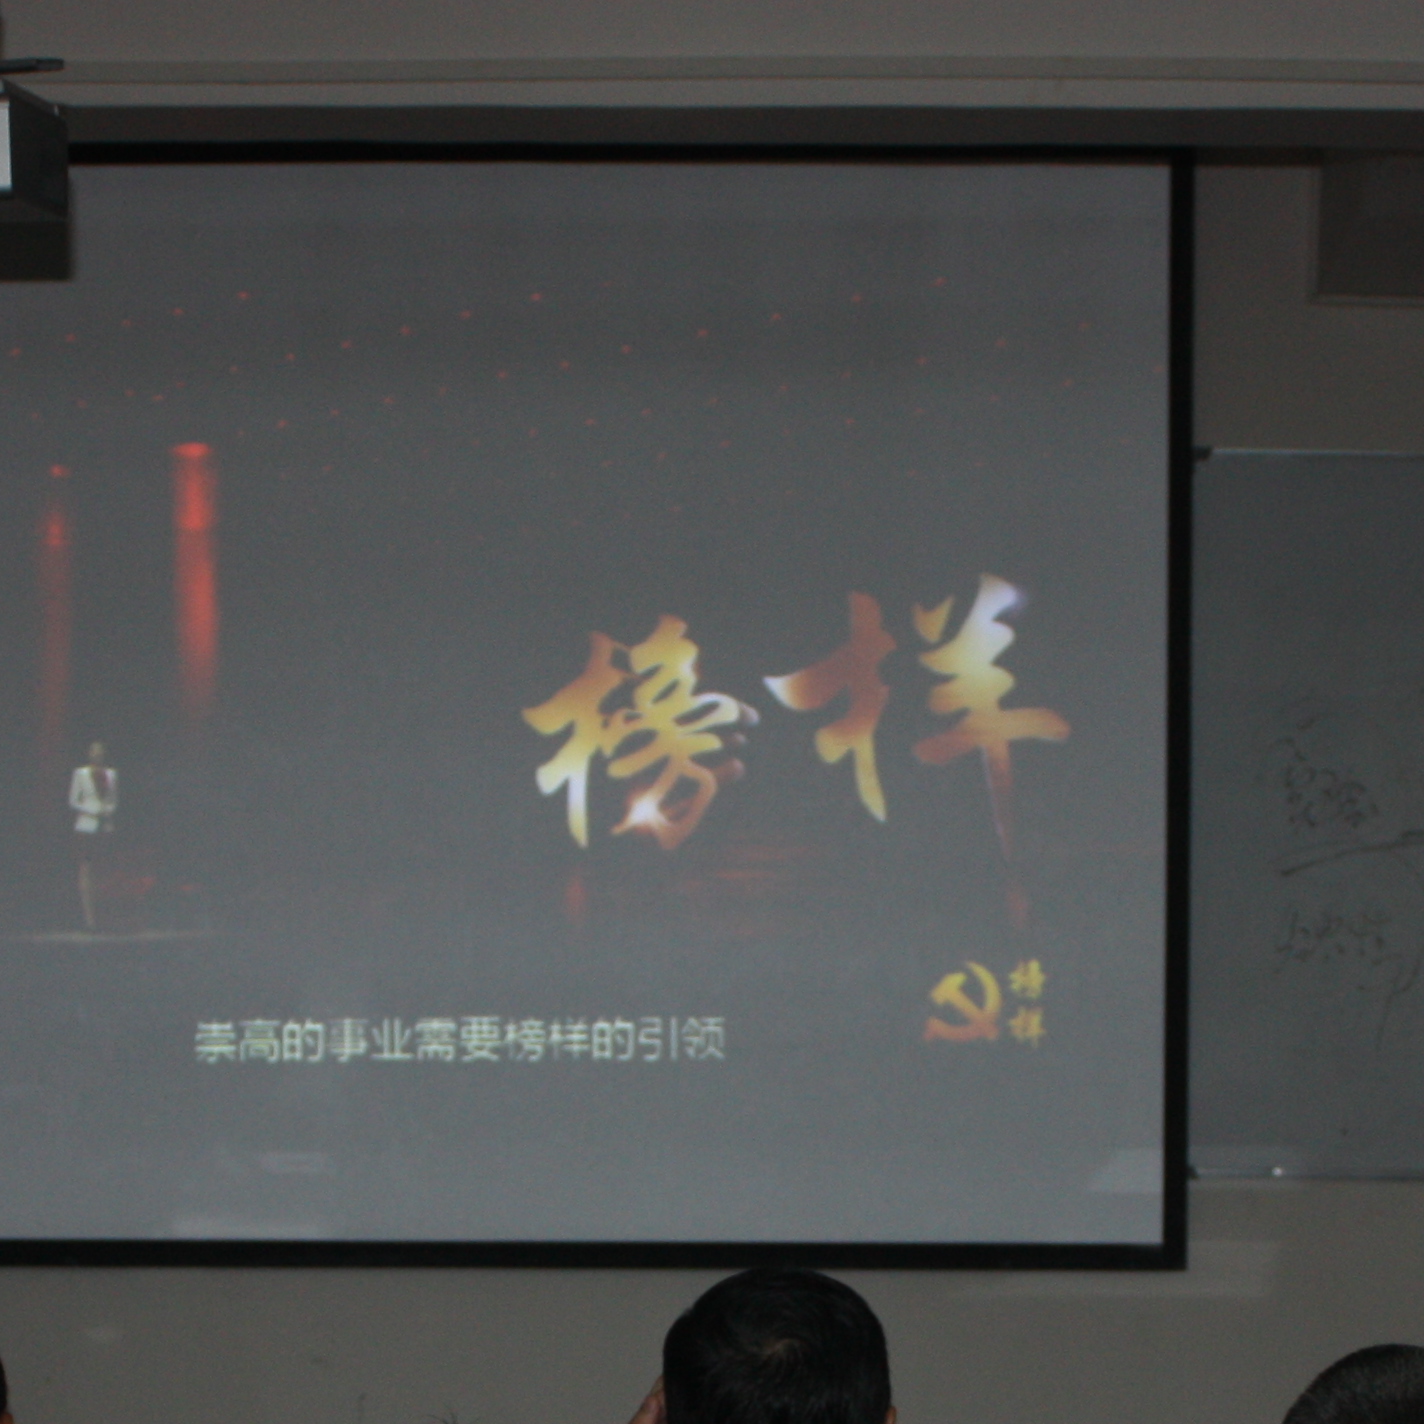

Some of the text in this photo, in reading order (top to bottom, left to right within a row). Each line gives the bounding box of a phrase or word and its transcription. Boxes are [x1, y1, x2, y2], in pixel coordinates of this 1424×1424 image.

[520, 572, 1072, 862] 榜样
[193, 1015, 726, 1063] 崇高的事业需要榜样的引领
